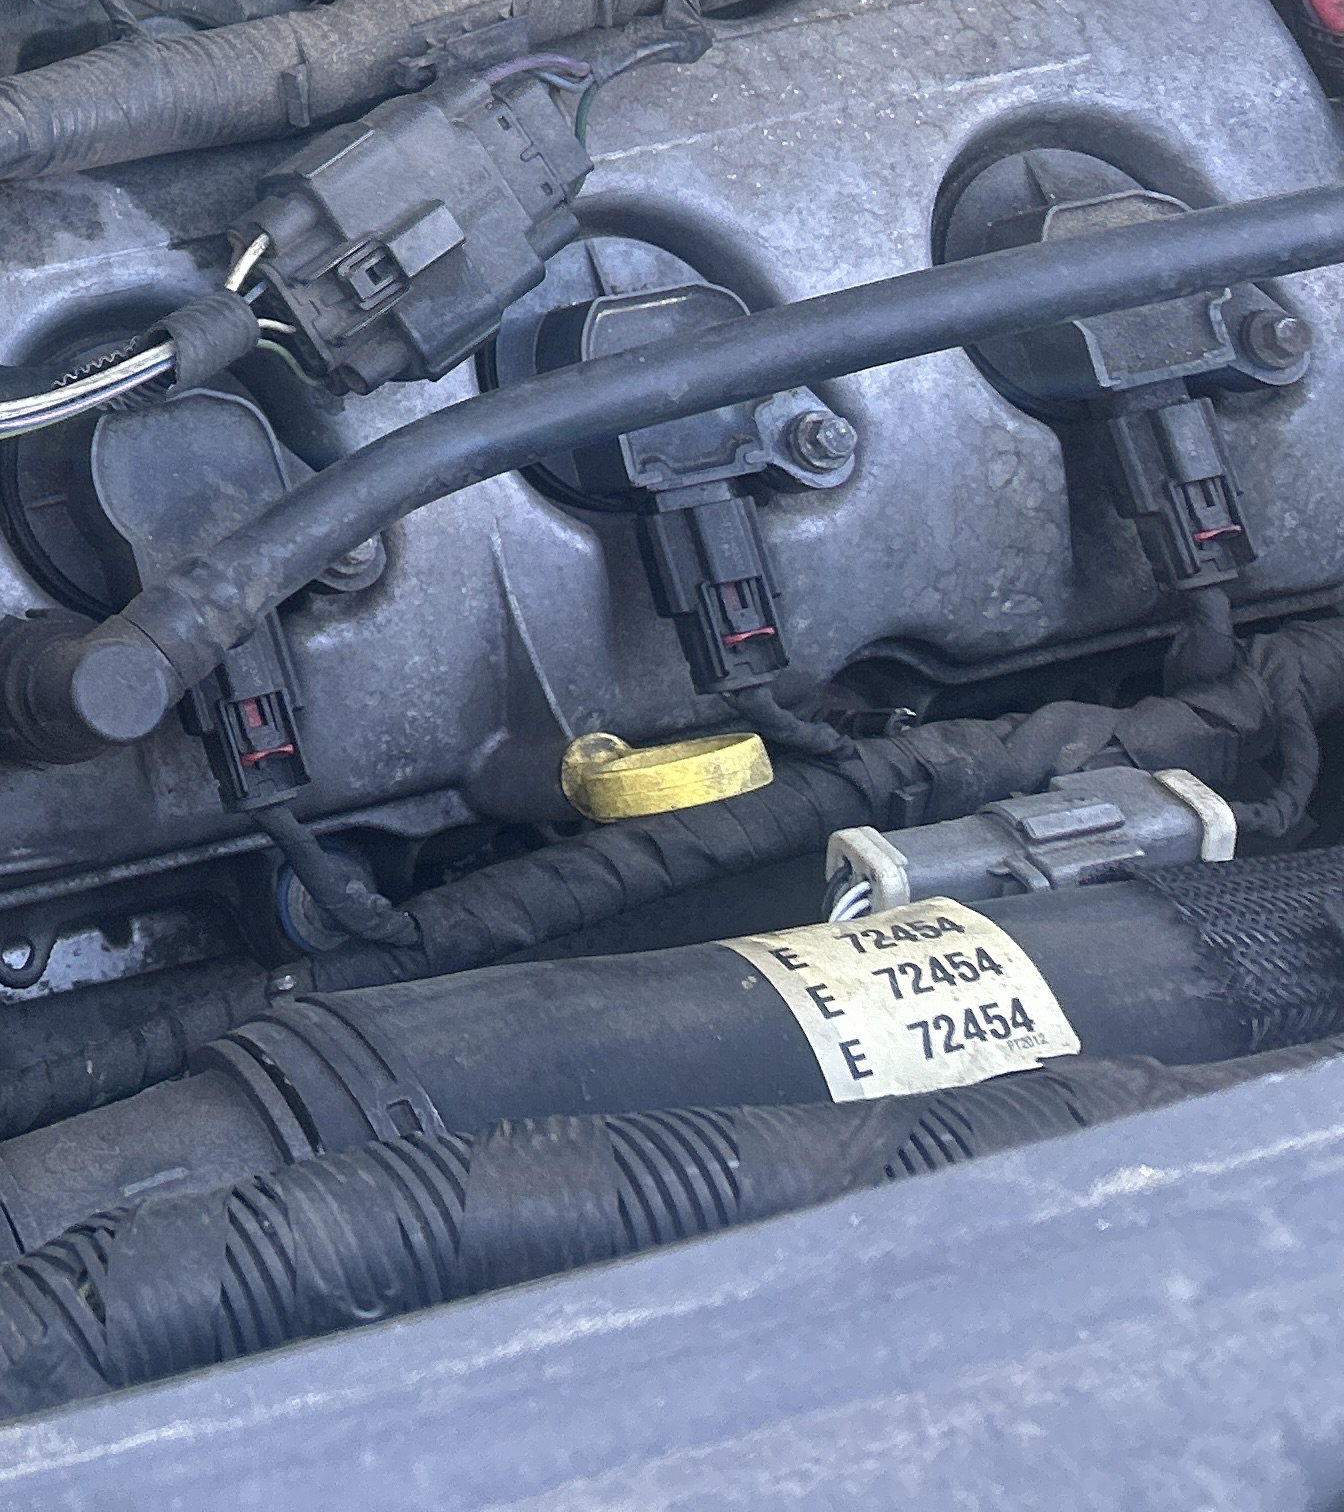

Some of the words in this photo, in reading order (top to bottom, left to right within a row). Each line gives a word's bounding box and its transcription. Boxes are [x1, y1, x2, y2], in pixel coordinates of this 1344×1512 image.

[769, 947, 810, 972] E
[834, 916, 966, 954] 72454
[805, 983, 846, 1019] E
[872, 946, 1004, 1000] 72454
[839, 1039, 874, 1080] E
[907, 997, 1036, 1060] 72454
